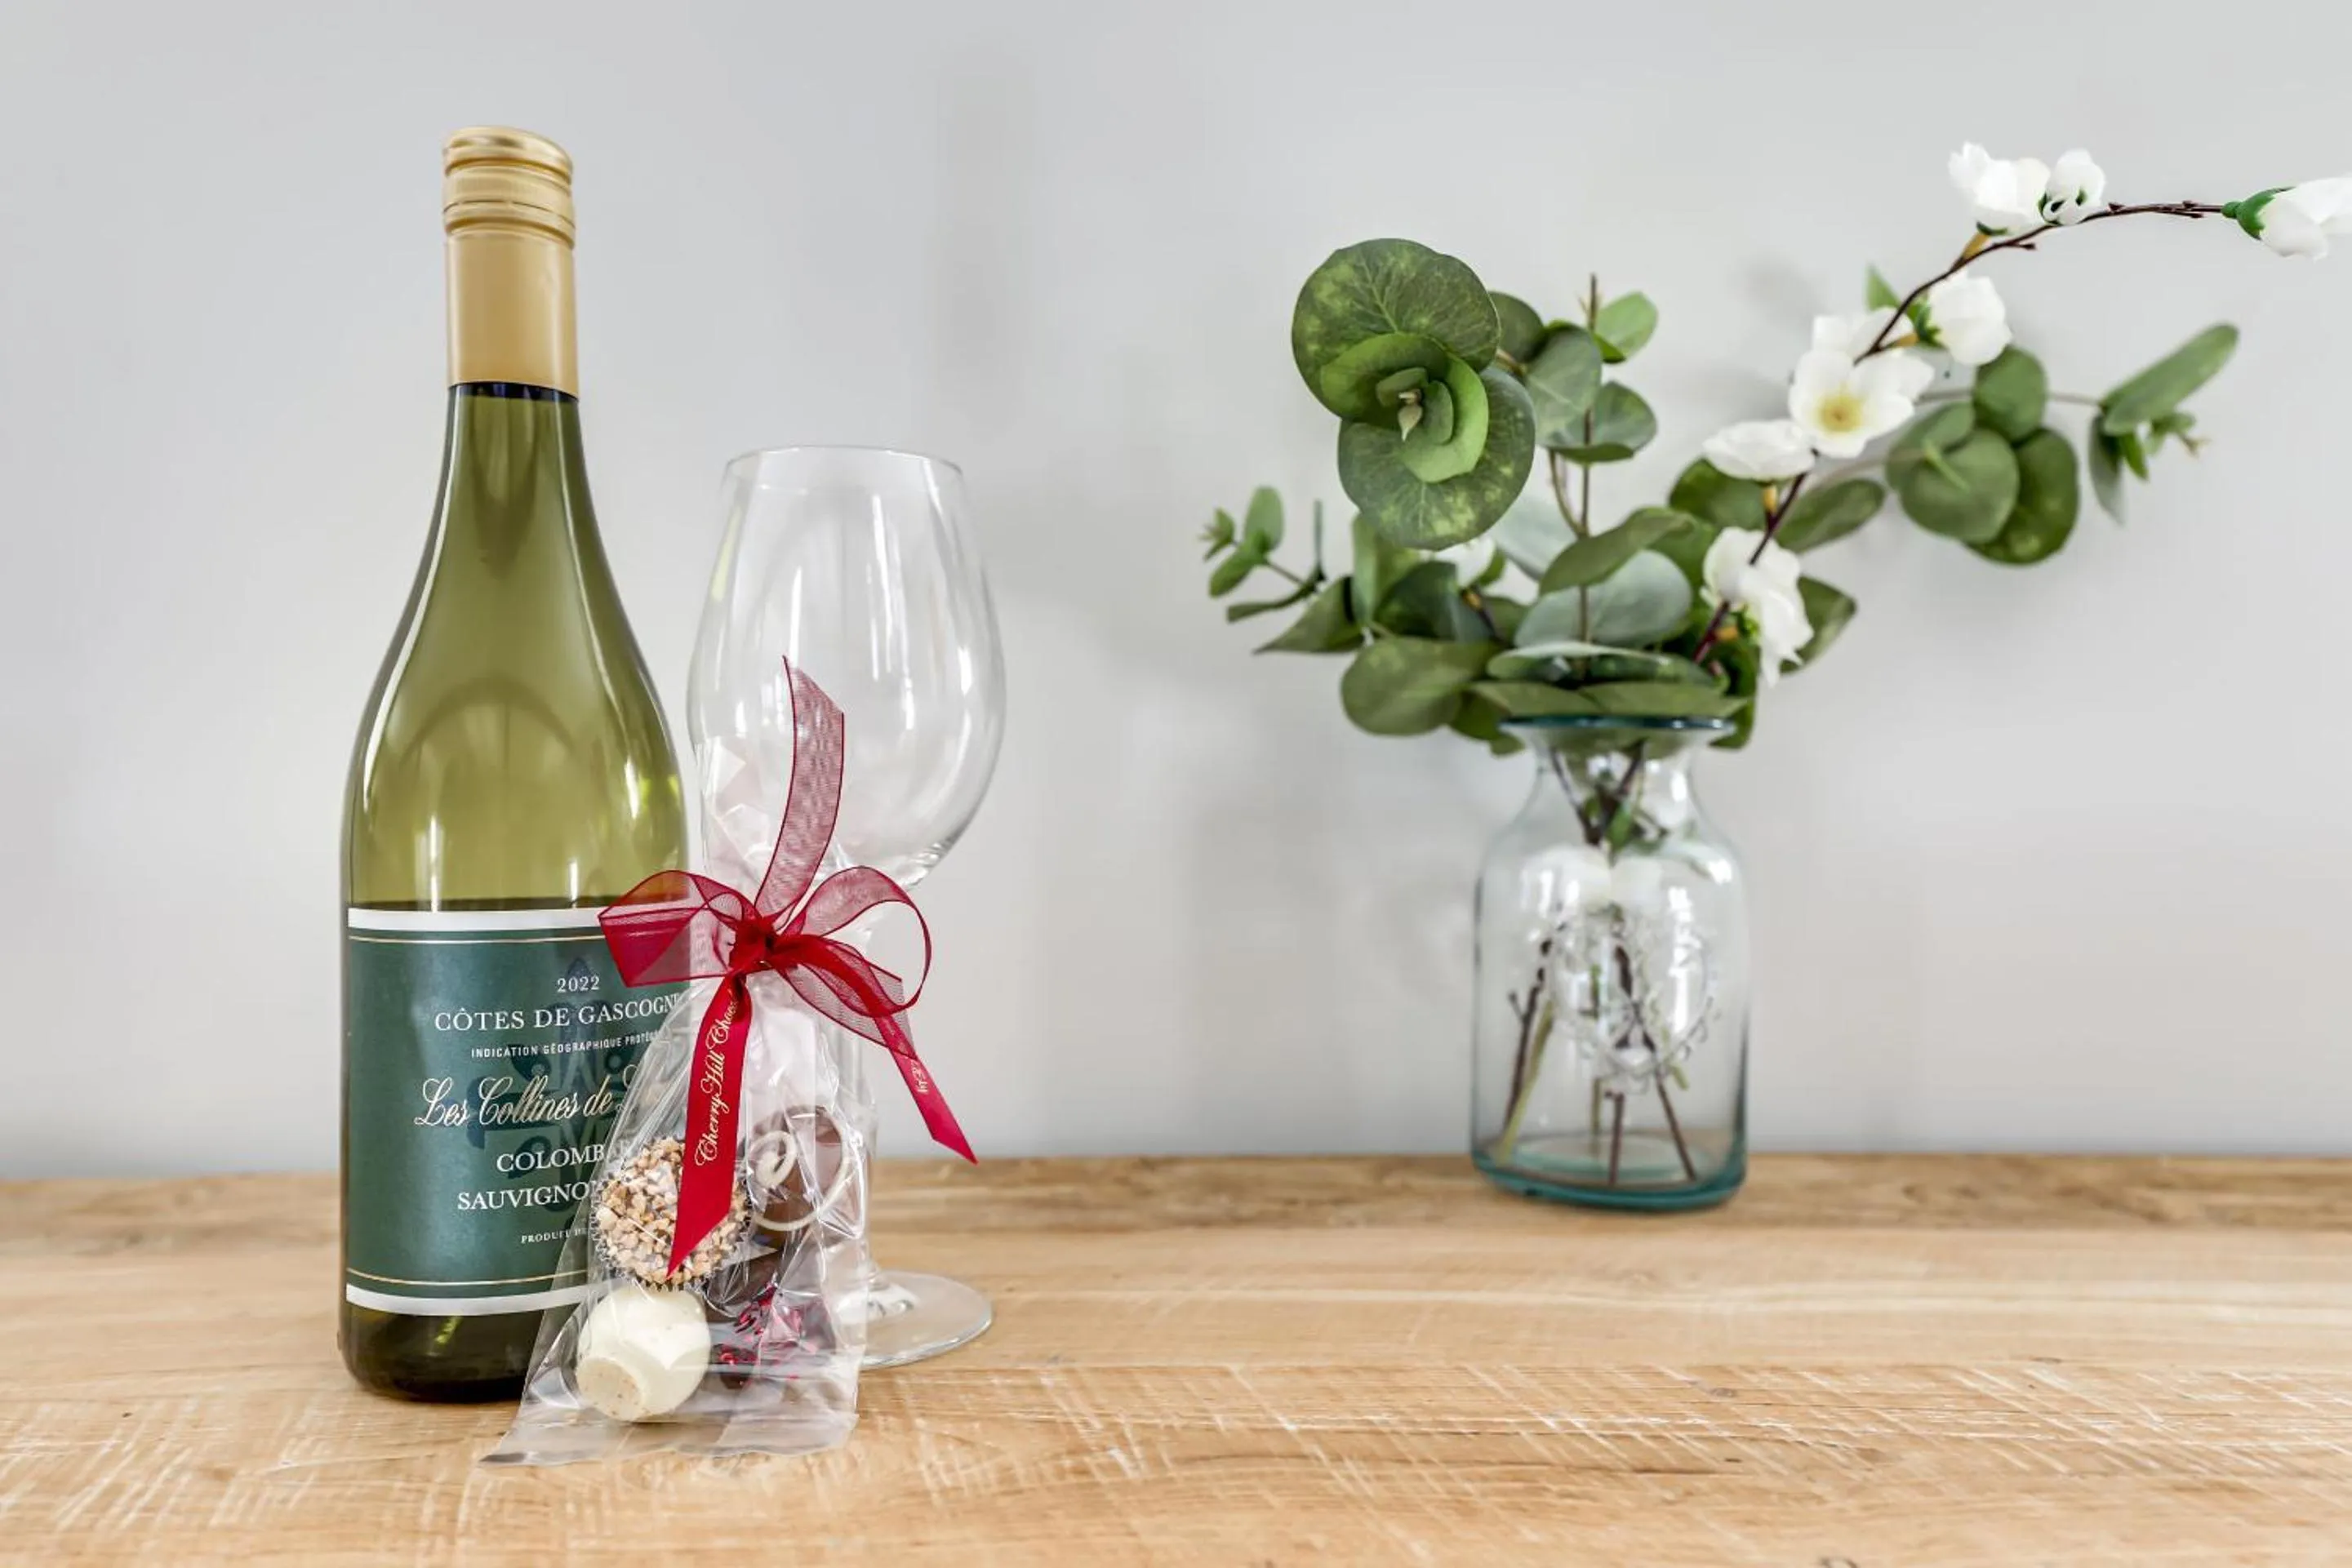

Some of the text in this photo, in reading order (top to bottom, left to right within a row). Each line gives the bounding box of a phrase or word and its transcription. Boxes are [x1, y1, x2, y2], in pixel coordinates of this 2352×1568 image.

[557, 975, 600, 993] 2022
[434, 1006, 525, 1032] CÔTES
[533, 1009, 571, 1028] DE
[470, 1046, 539, 1059] INDICATION
[543, 1037, 622, 1055] GÉOGRAPHIQUE
[700, 1050, 726, 1095] Hill
[413, 1077, 471, 1127] Les
[478, 1073, 581, 1126] Collines
[582, 1073, 614, 1117] de
[695, 1093, 731, 1166] Cherry
[496, 1144, 605, 1173] COLOMB
